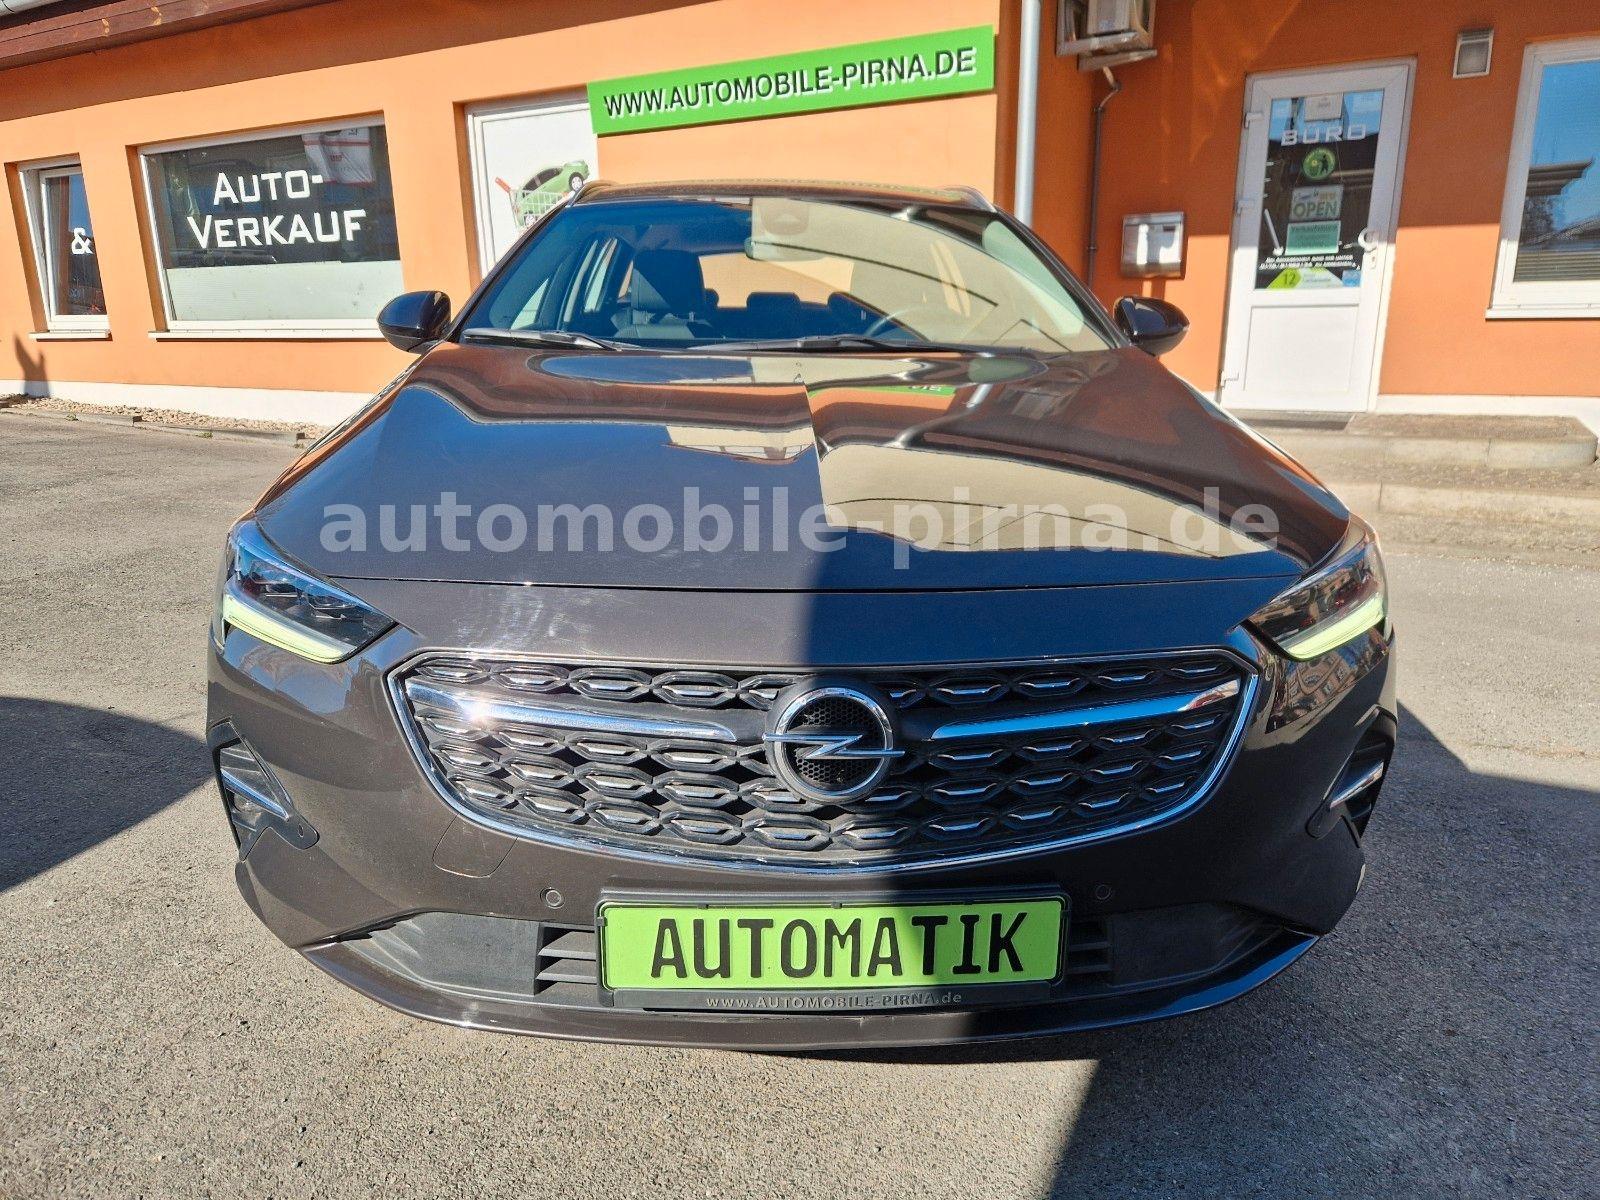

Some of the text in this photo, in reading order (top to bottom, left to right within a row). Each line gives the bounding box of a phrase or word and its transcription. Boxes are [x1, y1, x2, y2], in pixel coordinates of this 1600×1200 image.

[604, 46, 976, 117] WWW.AUTOMOBILE-PIRNA.DE
[213, 169, 323, 206] AUTO-
[1293, 201, 1338, 217] OPEN
[71, 227, 94, 255] &
[187, 209, 365, 249] VERKAUF
[651, 912, 1028, 979] AUTOMATIK
[706, 992, 962, 1009] www.AUTOMOBILE-PIRNA.de
